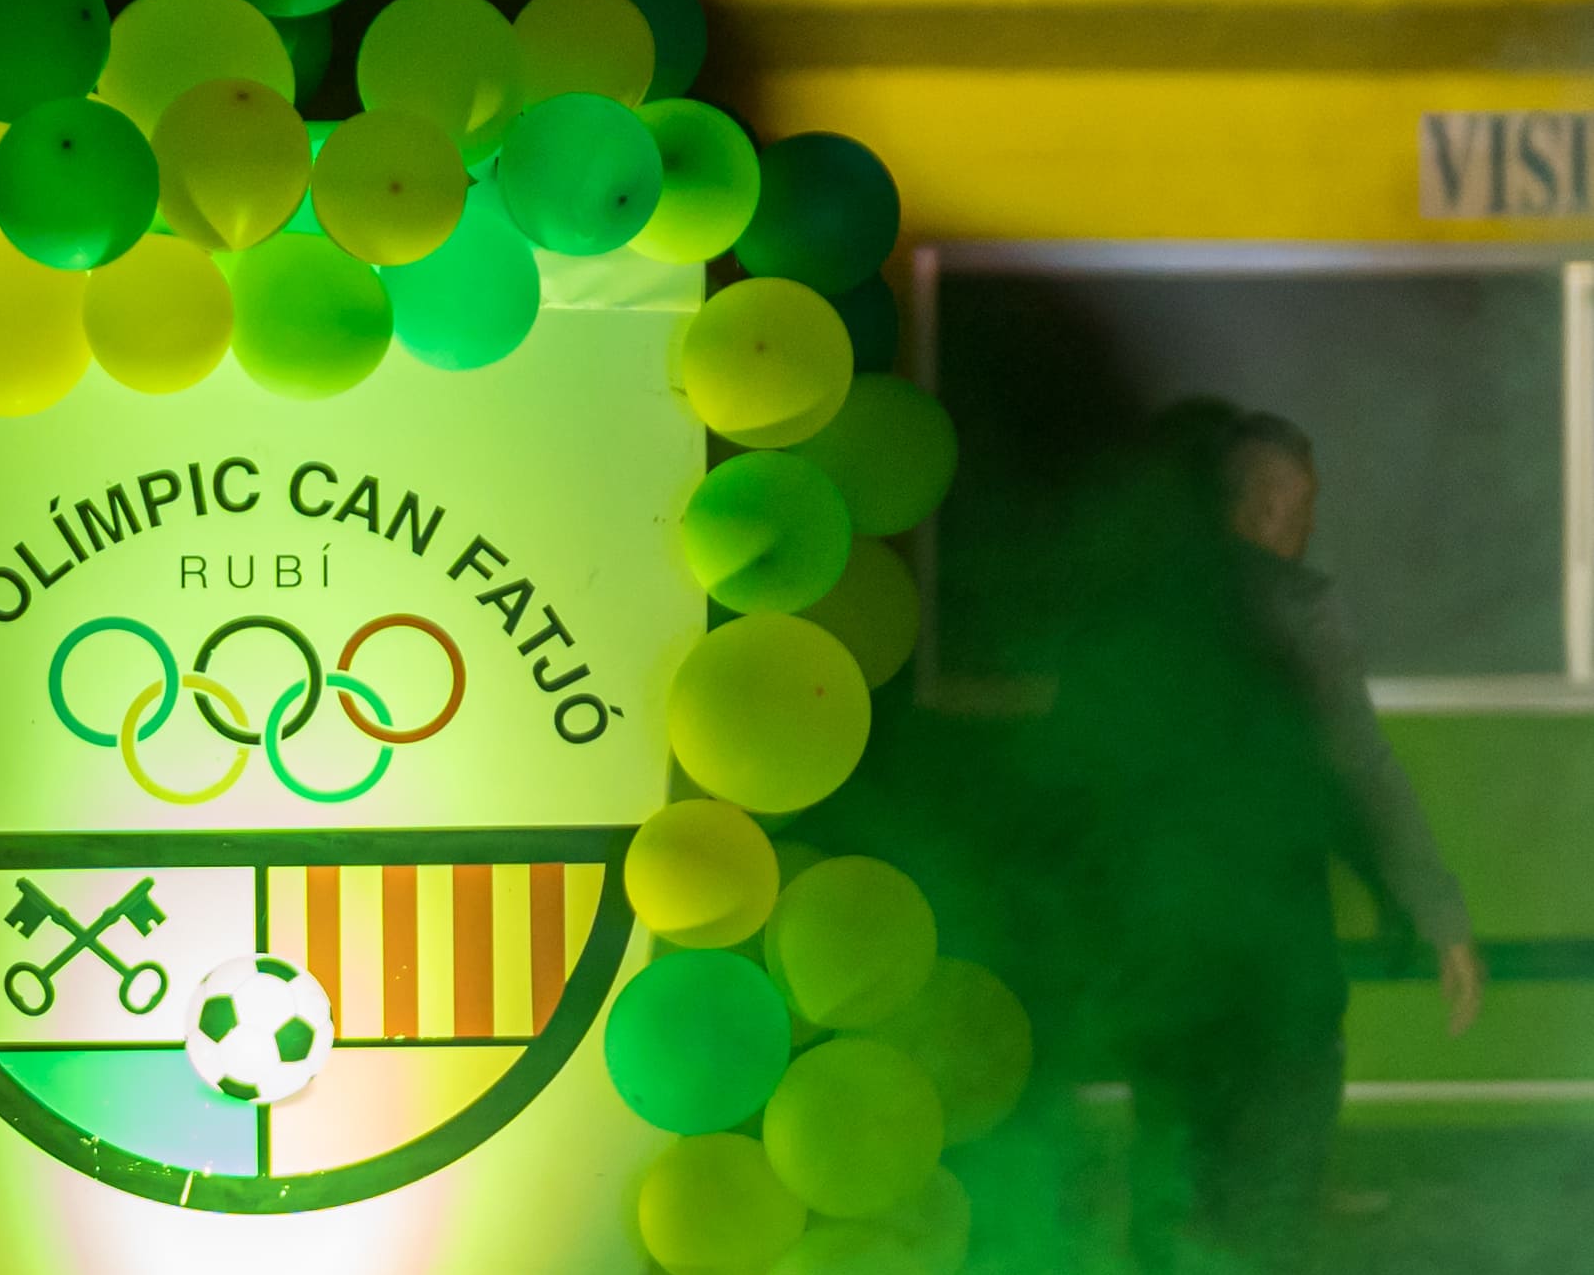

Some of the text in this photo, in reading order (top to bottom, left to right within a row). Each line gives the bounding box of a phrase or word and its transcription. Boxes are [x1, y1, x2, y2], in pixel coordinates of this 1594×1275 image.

[180, 543, 331, 590] RUBÍ
[290, 460, 446, 556] CAN
[445, 533, 625, 745] FATJÓ
